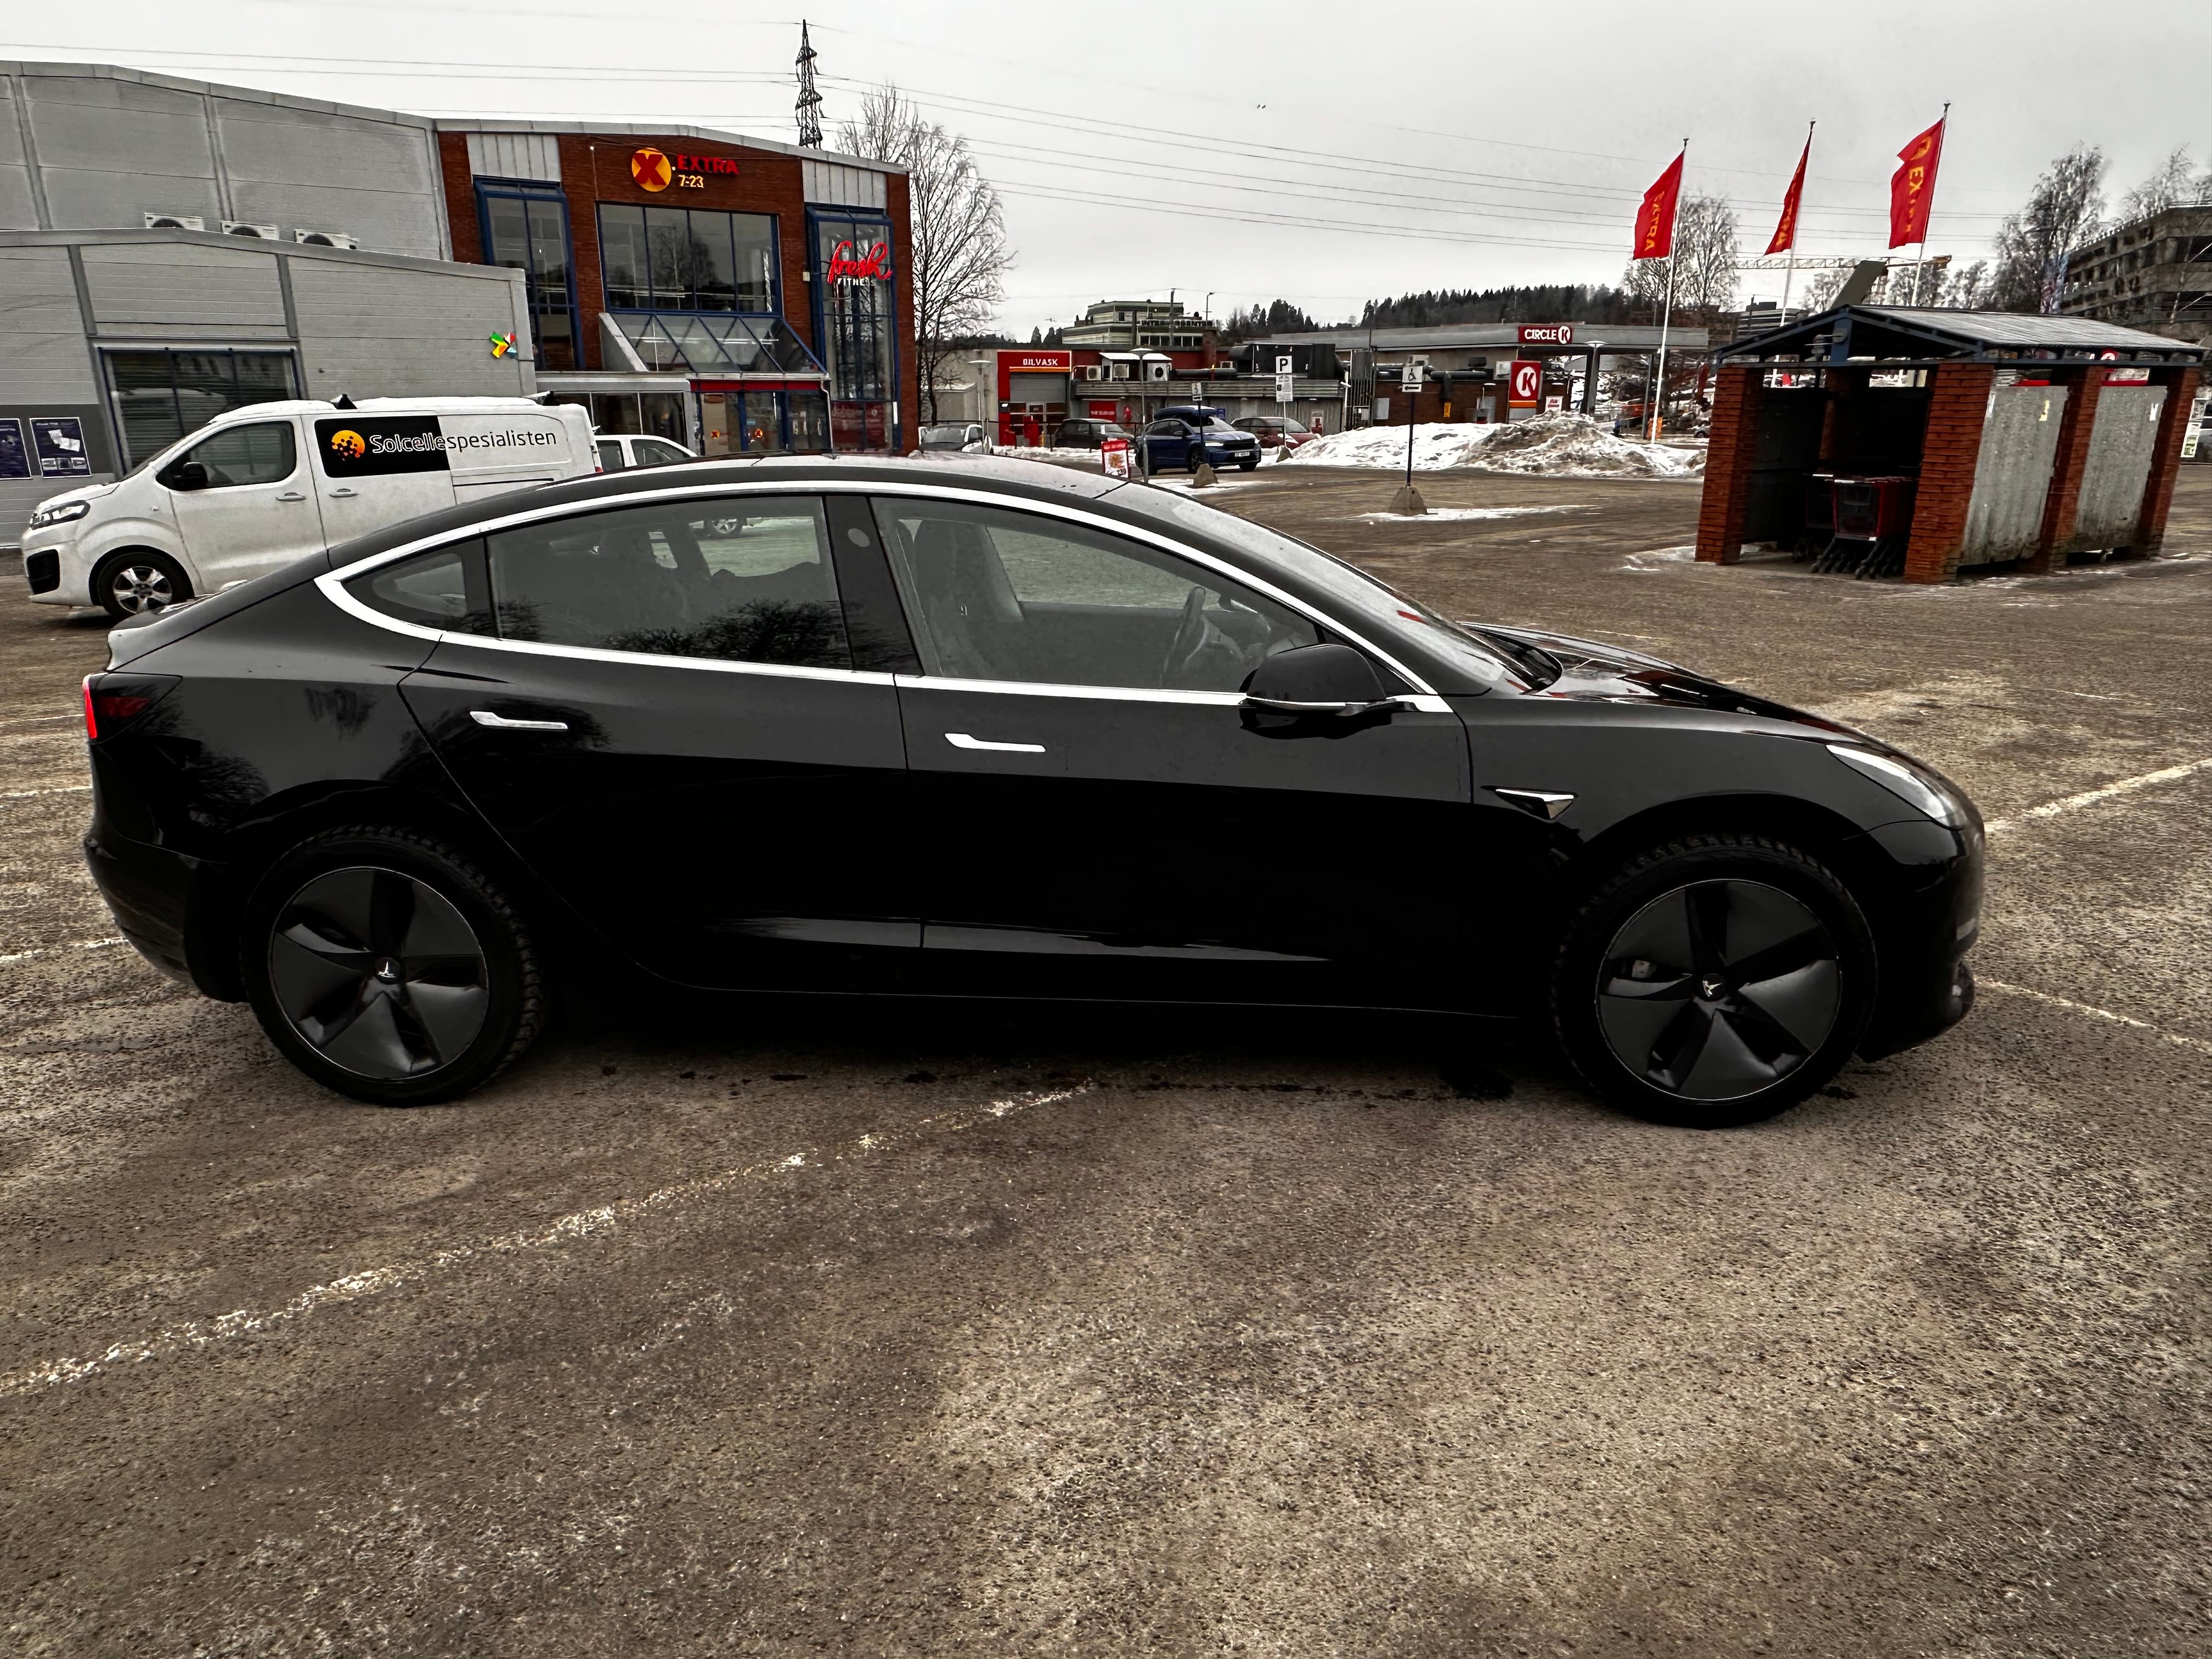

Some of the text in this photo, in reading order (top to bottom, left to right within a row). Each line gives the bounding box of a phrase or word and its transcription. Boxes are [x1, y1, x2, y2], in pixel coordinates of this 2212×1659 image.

[677, 153, 740, 174] EXTRA
[678, 174, 704, 189] 7-23
[827, 240, 893, 285] fresh
[837, 278, 875, 286] FITNE
[1524, 328, 1570, 343] CIRCLE K
[1279, 358, 1289, 372] P
[1520, 371, 1536, 394] K
[370, 430, 557, 454] Solcellespesialisten
